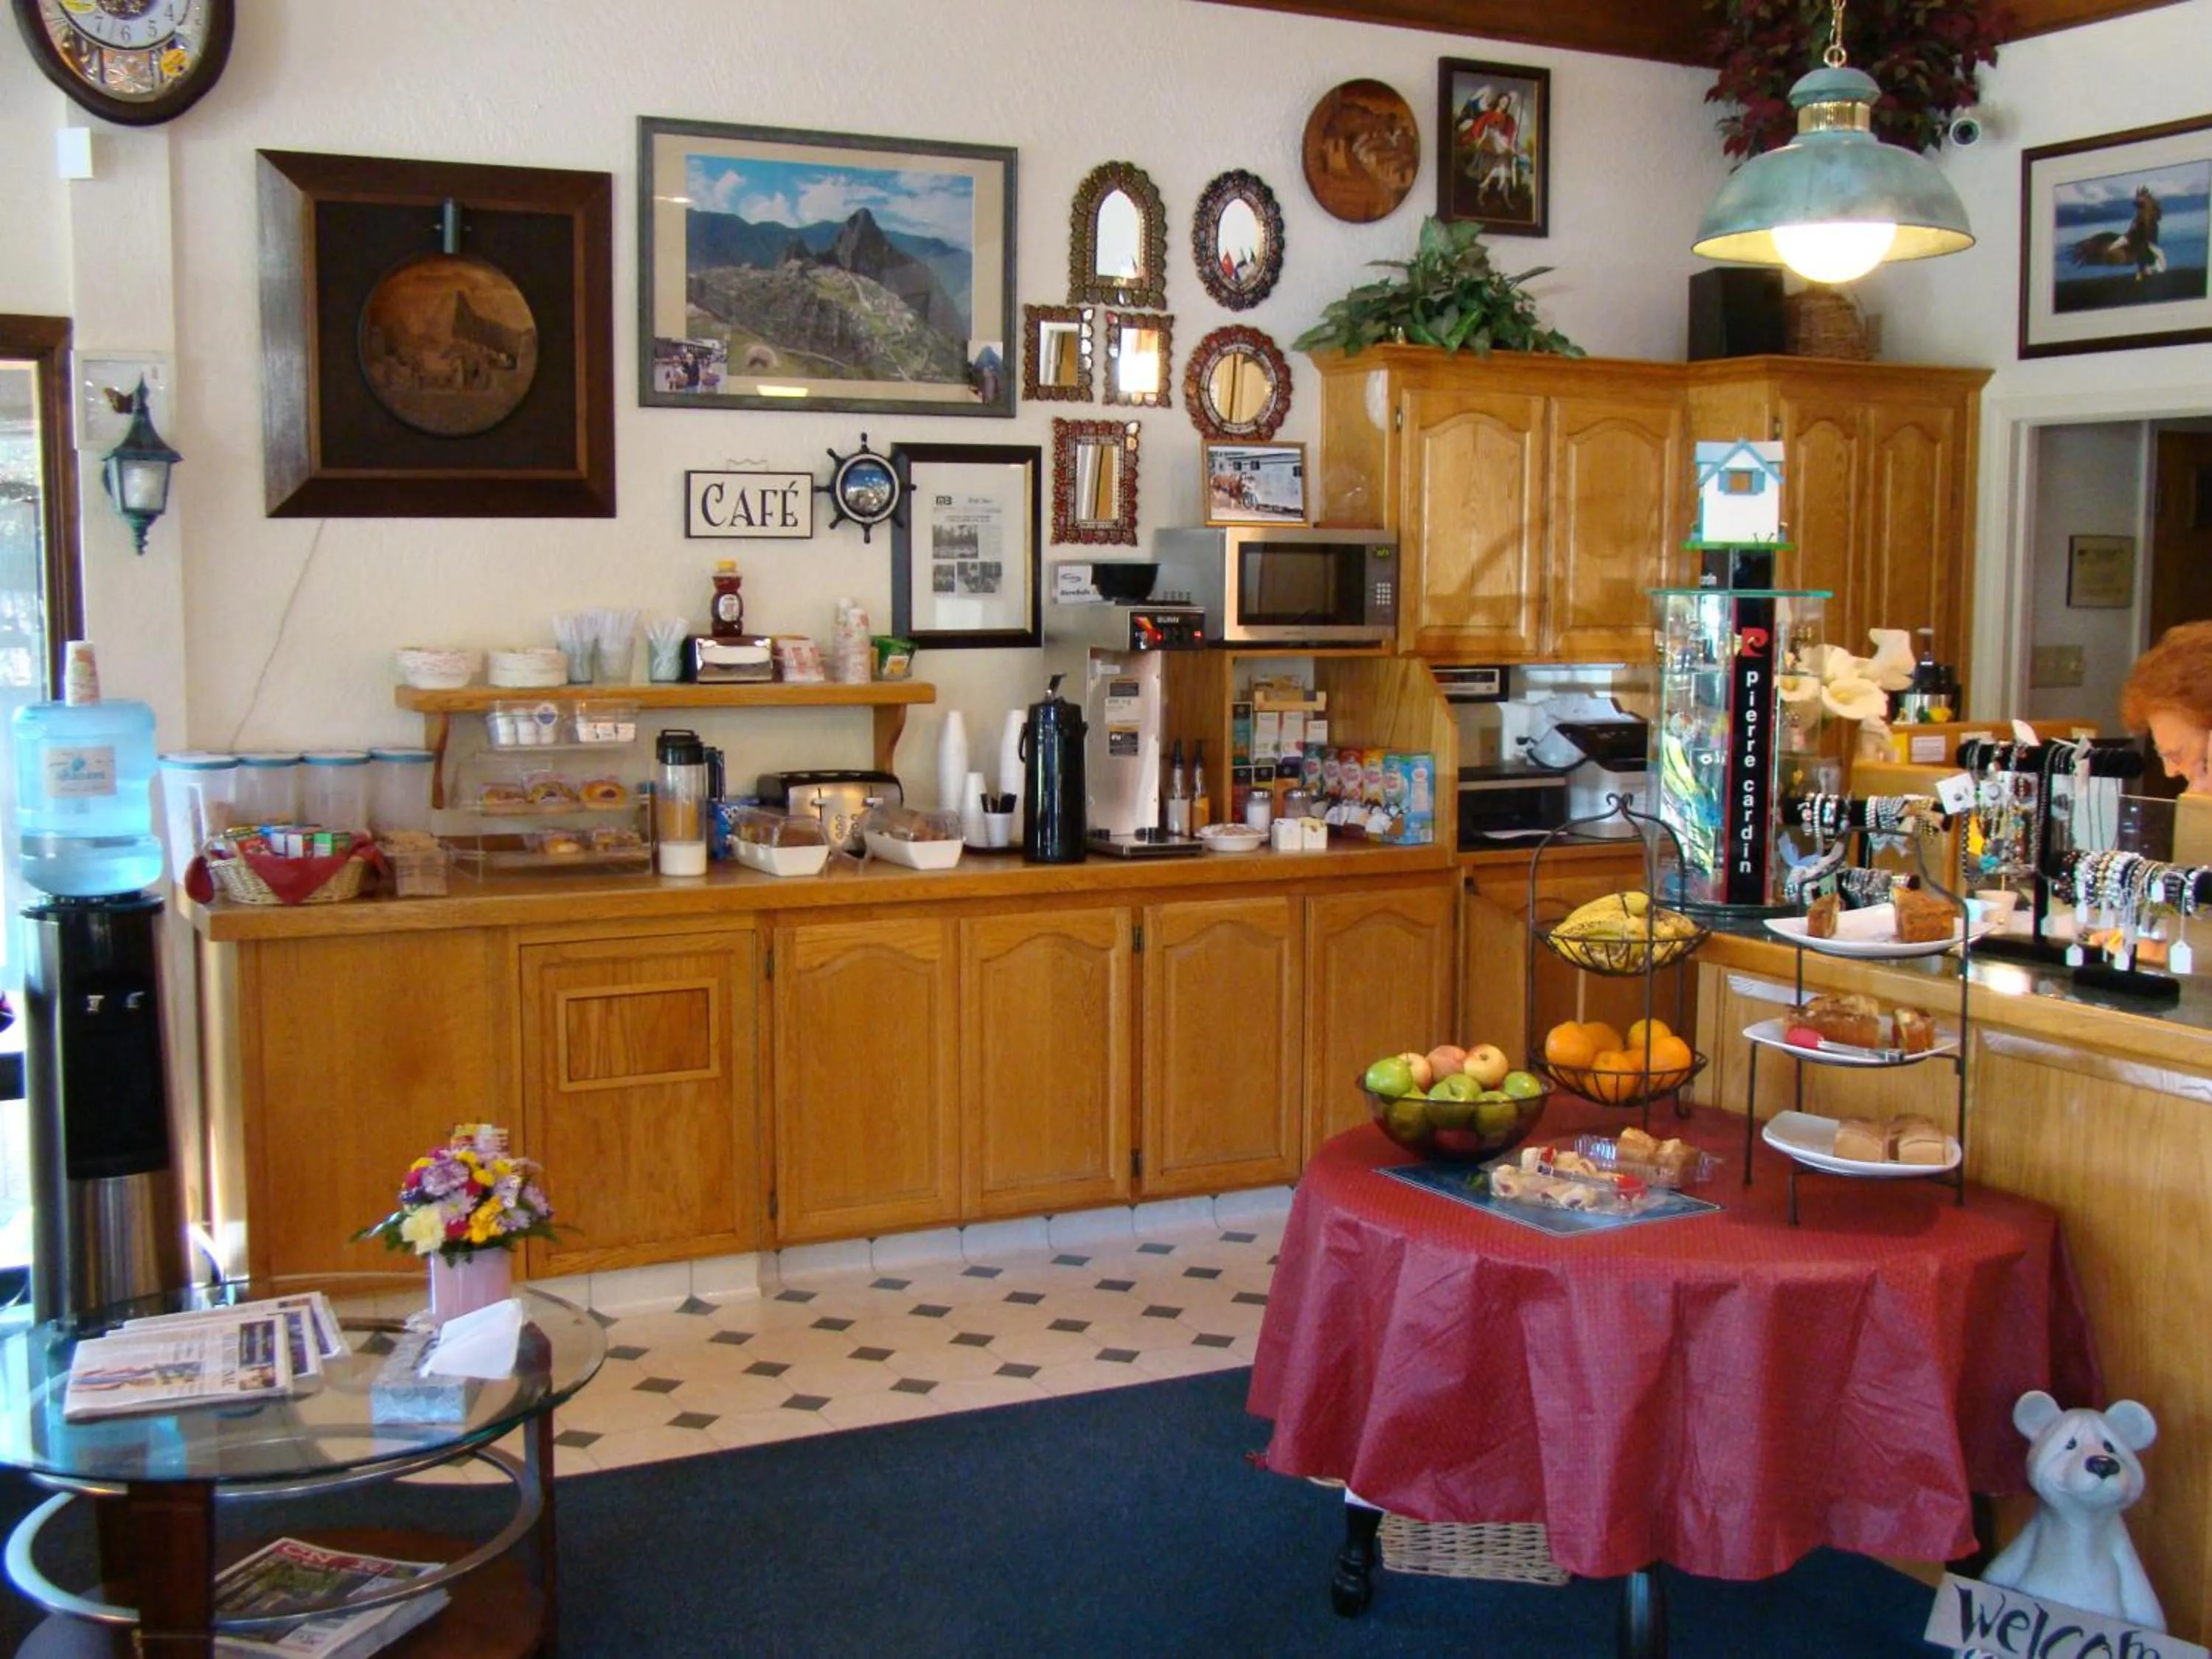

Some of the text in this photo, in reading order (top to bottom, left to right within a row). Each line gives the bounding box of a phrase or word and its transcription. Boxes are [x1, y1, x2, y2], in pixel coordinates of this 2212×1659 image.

[163, 4, 175, 21] 4
[94, 16, 103, 33] 7
[148, 20, 157, 37] 5
[120, 25, 131, 44] 6
[701, 481, 799, 527] CAFÉ
[1739, 670, 1759, 874] pierre cardin
